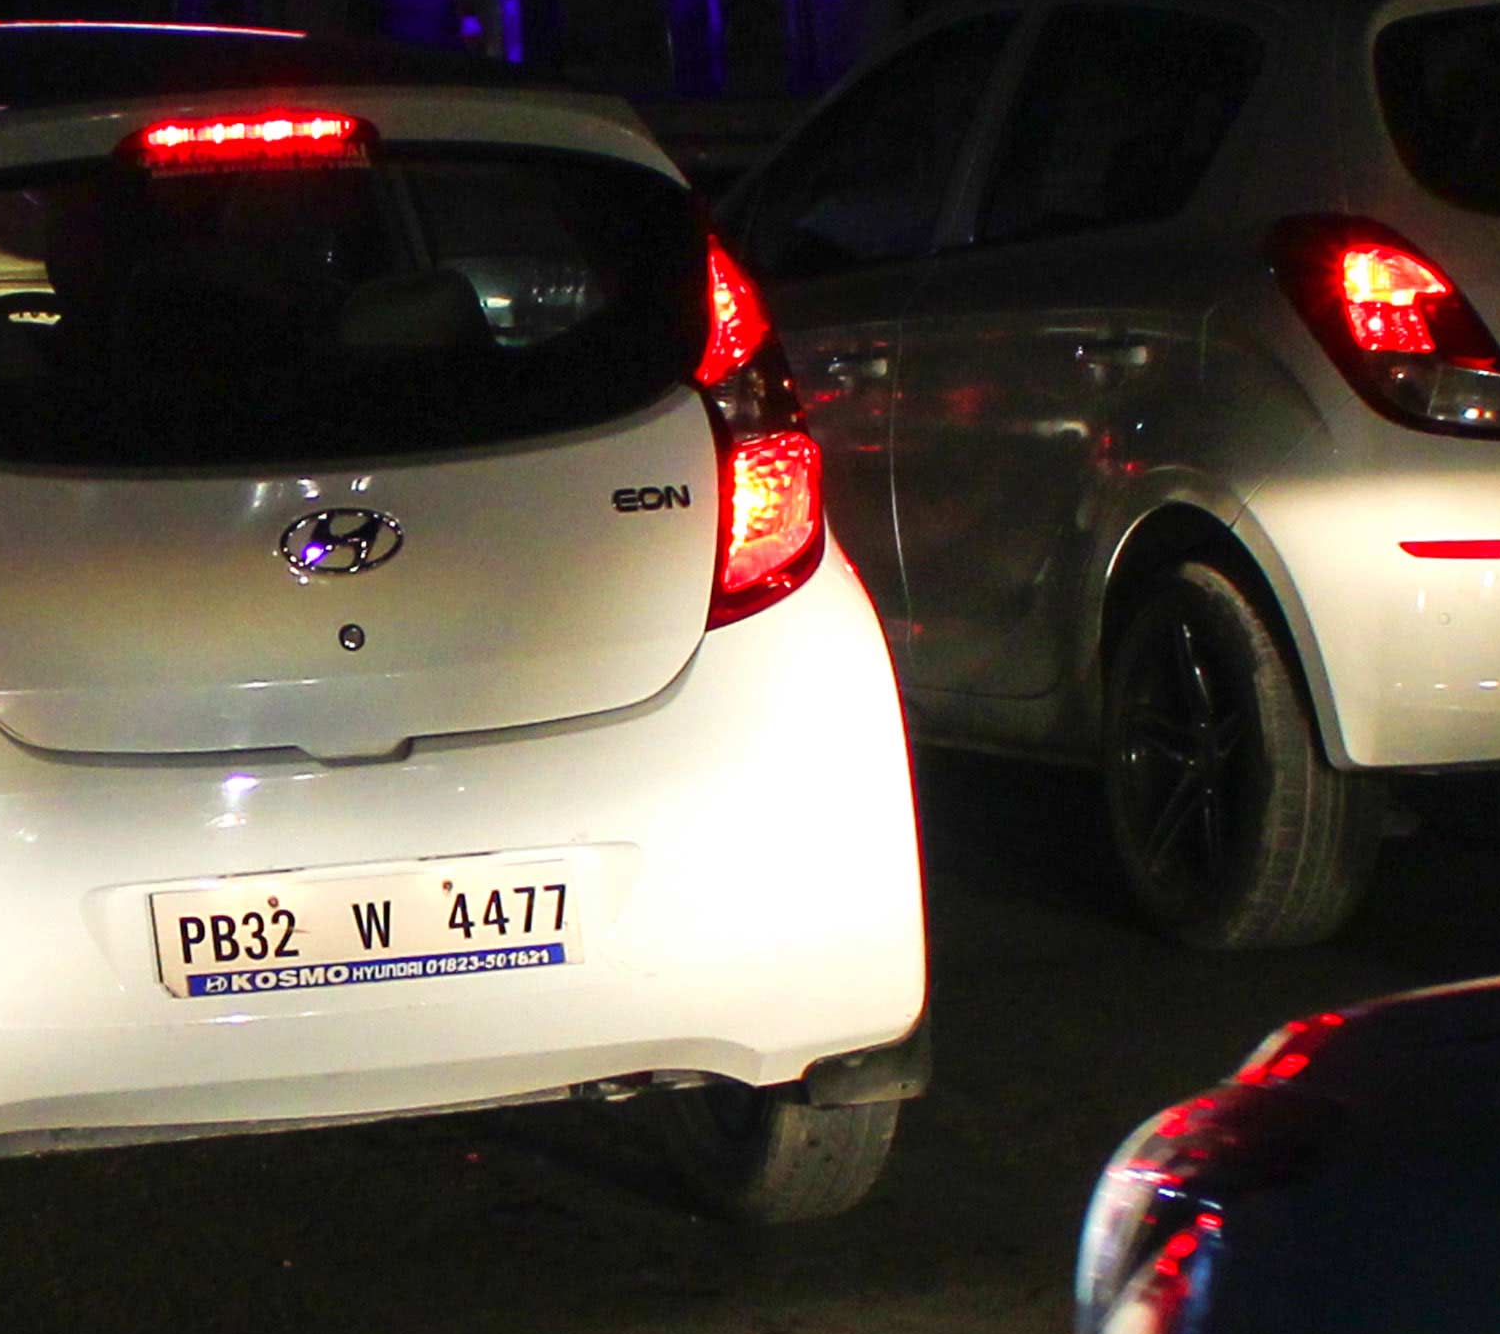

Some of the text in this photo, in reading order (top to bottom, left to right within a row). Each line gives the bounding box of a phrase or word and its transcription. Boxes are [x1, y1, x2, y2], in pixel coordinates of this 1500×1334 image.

[613, 484, 691, 512] EON
[179, 884, 568, 965] PB32 W 4477
[230, 963, 351, 992] KOSMO
[352, 962, 423, 982] HYUNDAI
